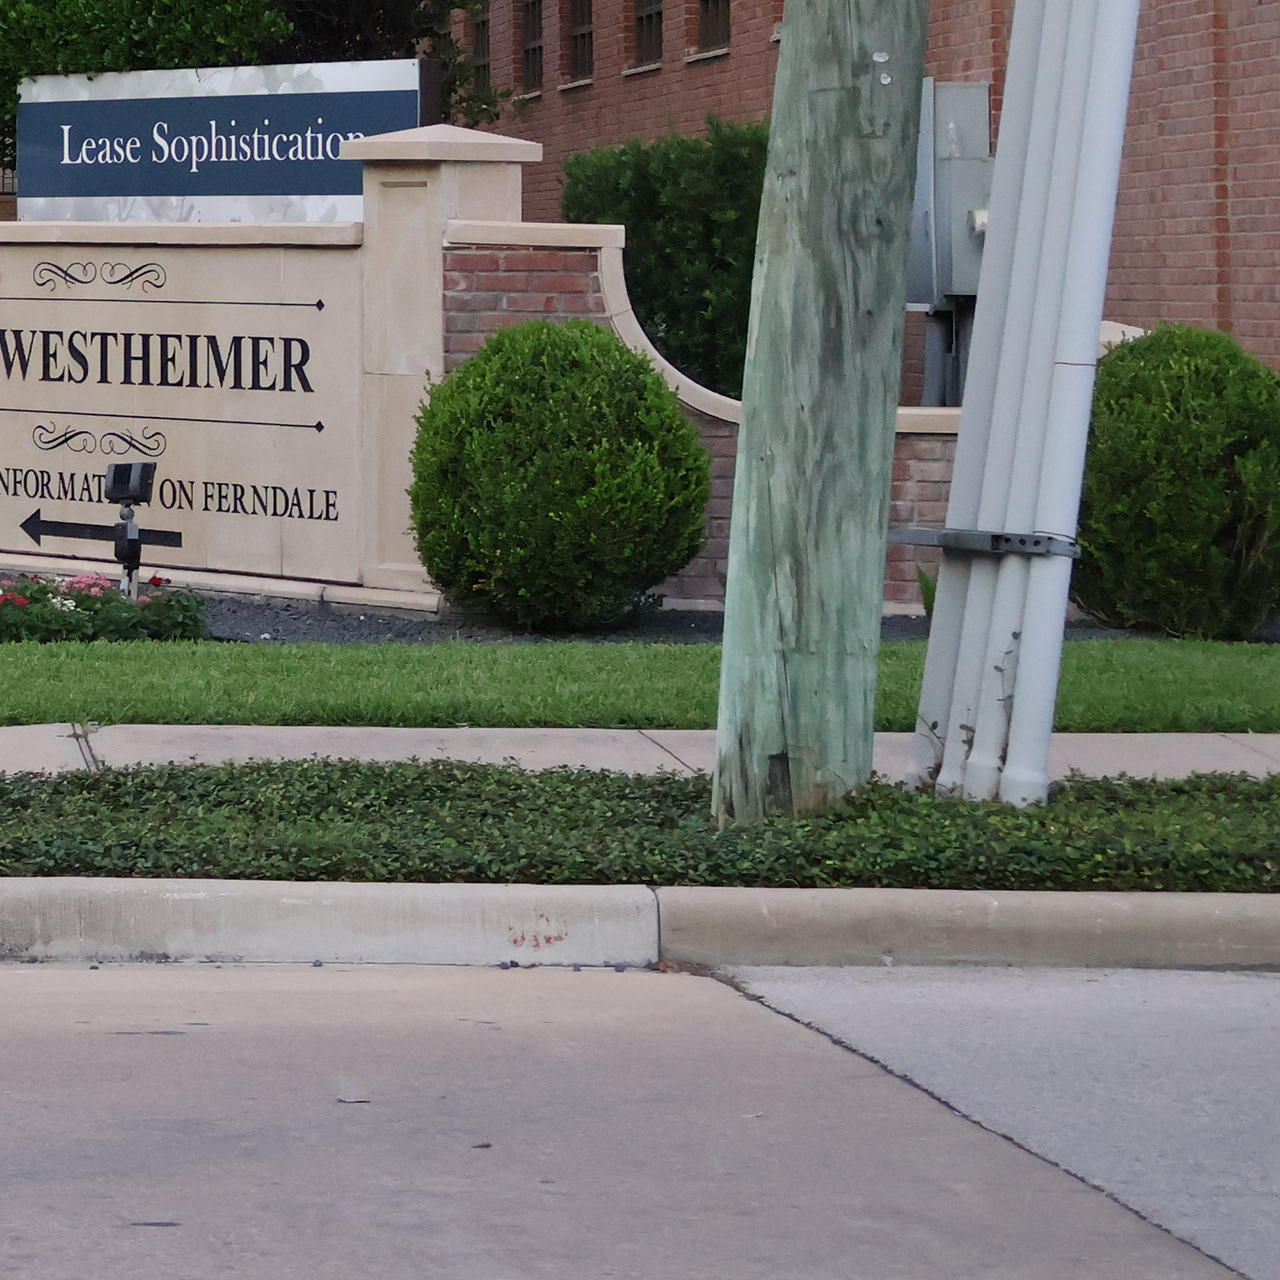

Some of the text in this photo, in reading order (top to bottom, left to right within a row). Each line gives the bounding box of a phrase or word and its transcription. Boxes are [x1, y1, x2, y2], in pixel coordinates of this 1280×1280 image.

[60, 124, 140, 165] Lease
[159, 478, 195, 510] ON
[202, 481, 339, 521] FERNDALE
